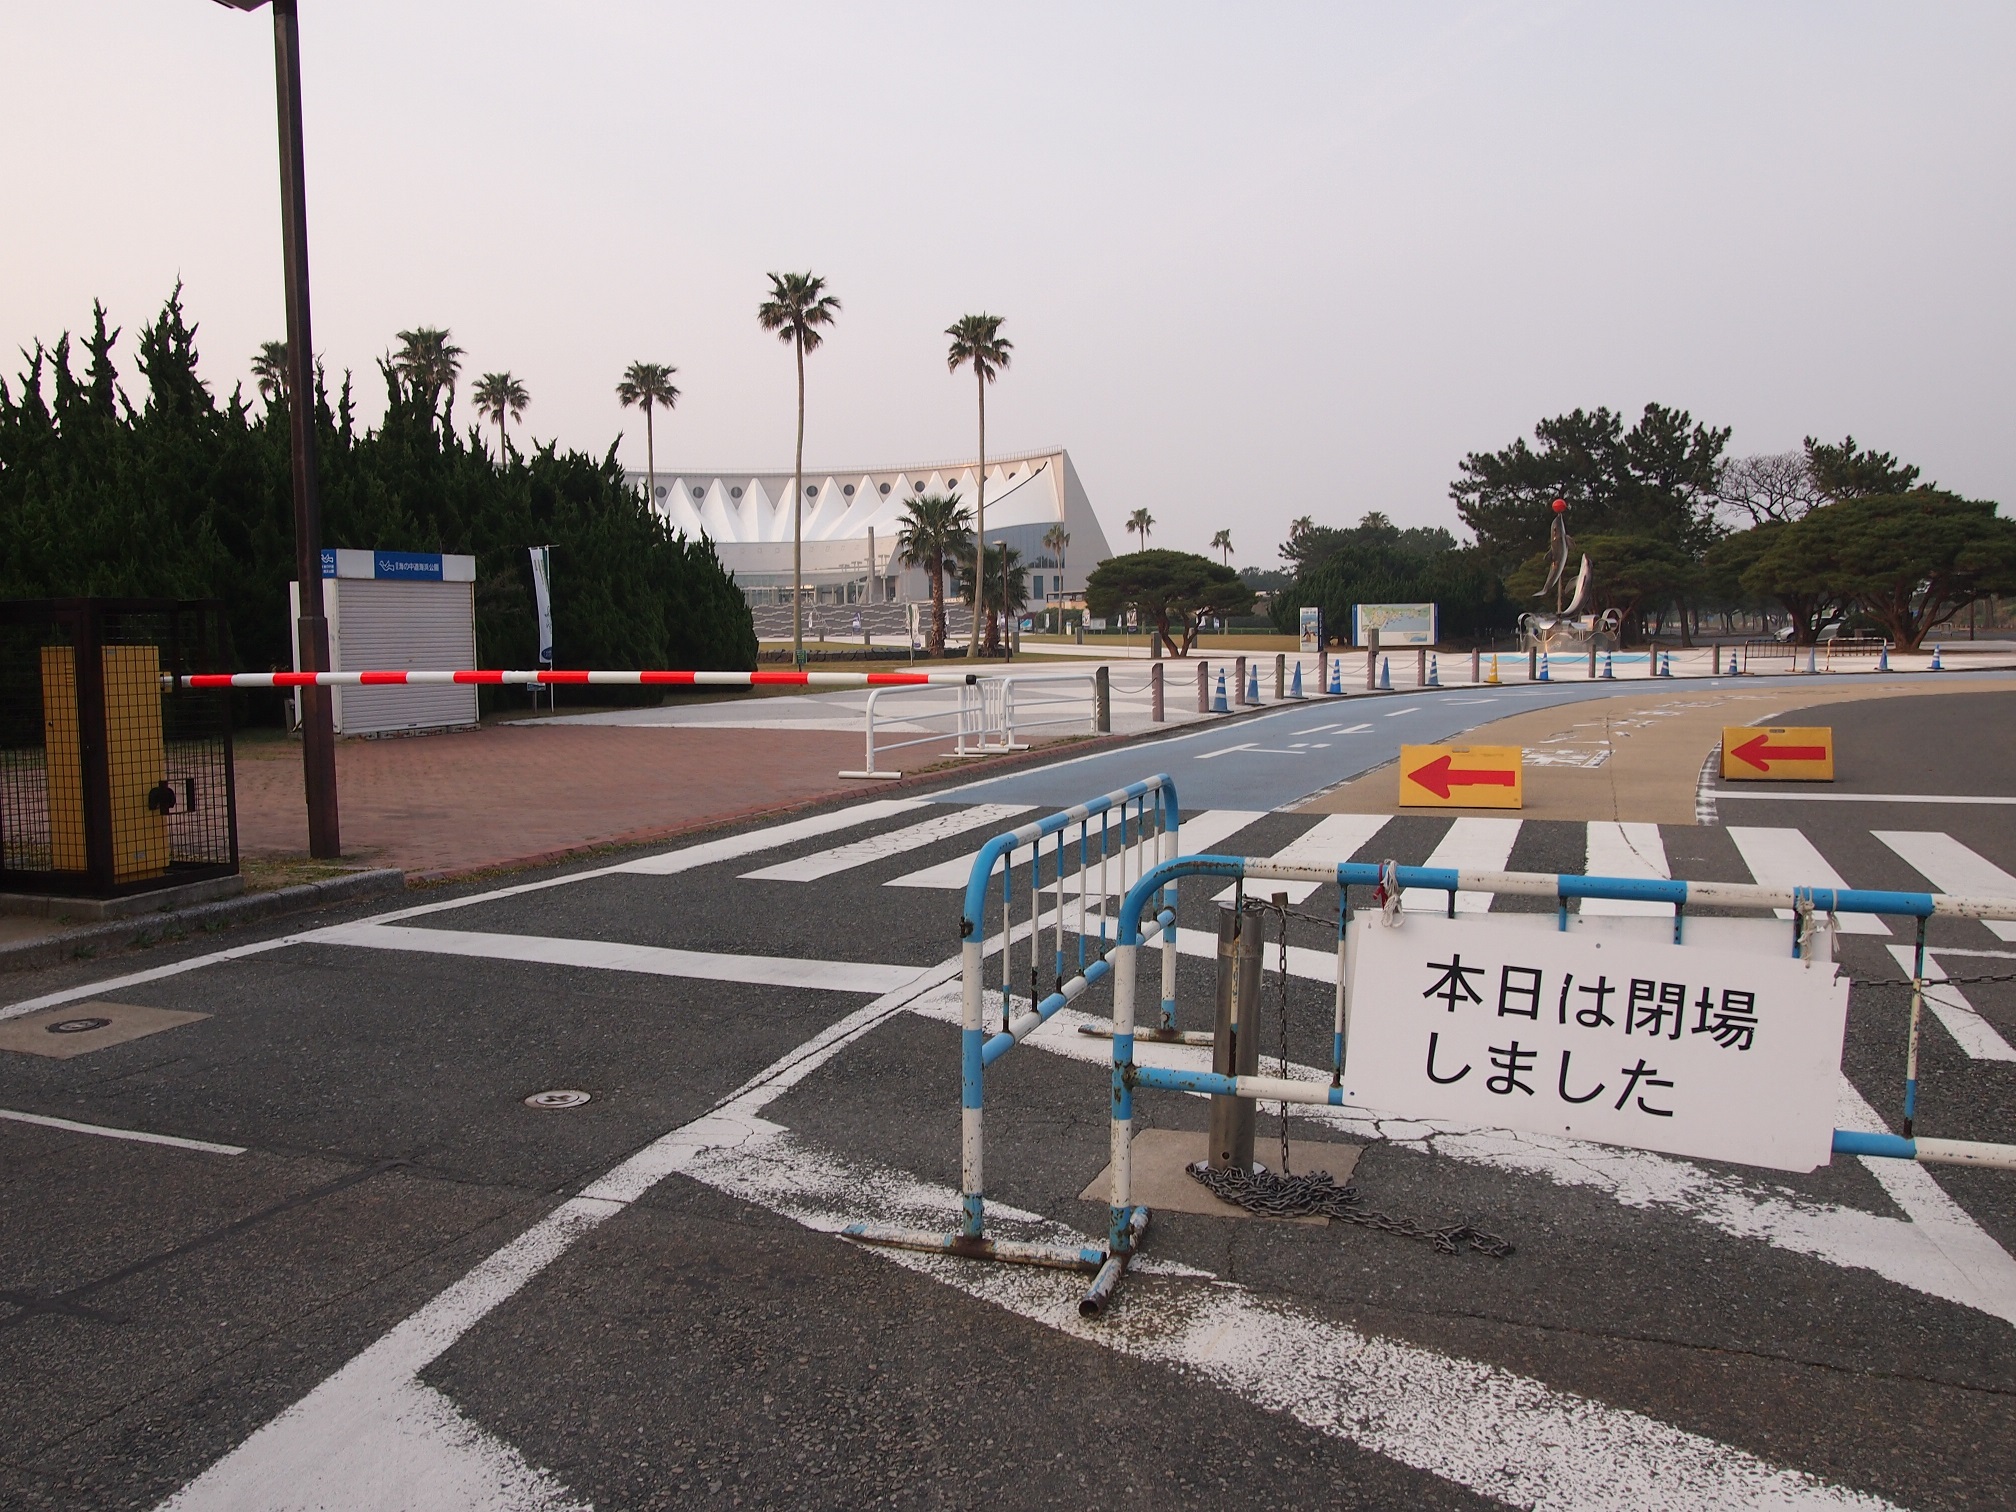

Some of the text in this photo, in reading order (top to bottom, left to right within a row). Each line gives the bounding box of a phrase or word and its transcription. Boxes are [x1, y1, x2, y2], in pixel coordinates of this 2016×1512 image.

[1422, 953, 1759, 1051] 本日は閉場
[1426, 1031, 1674, 1118] しました
